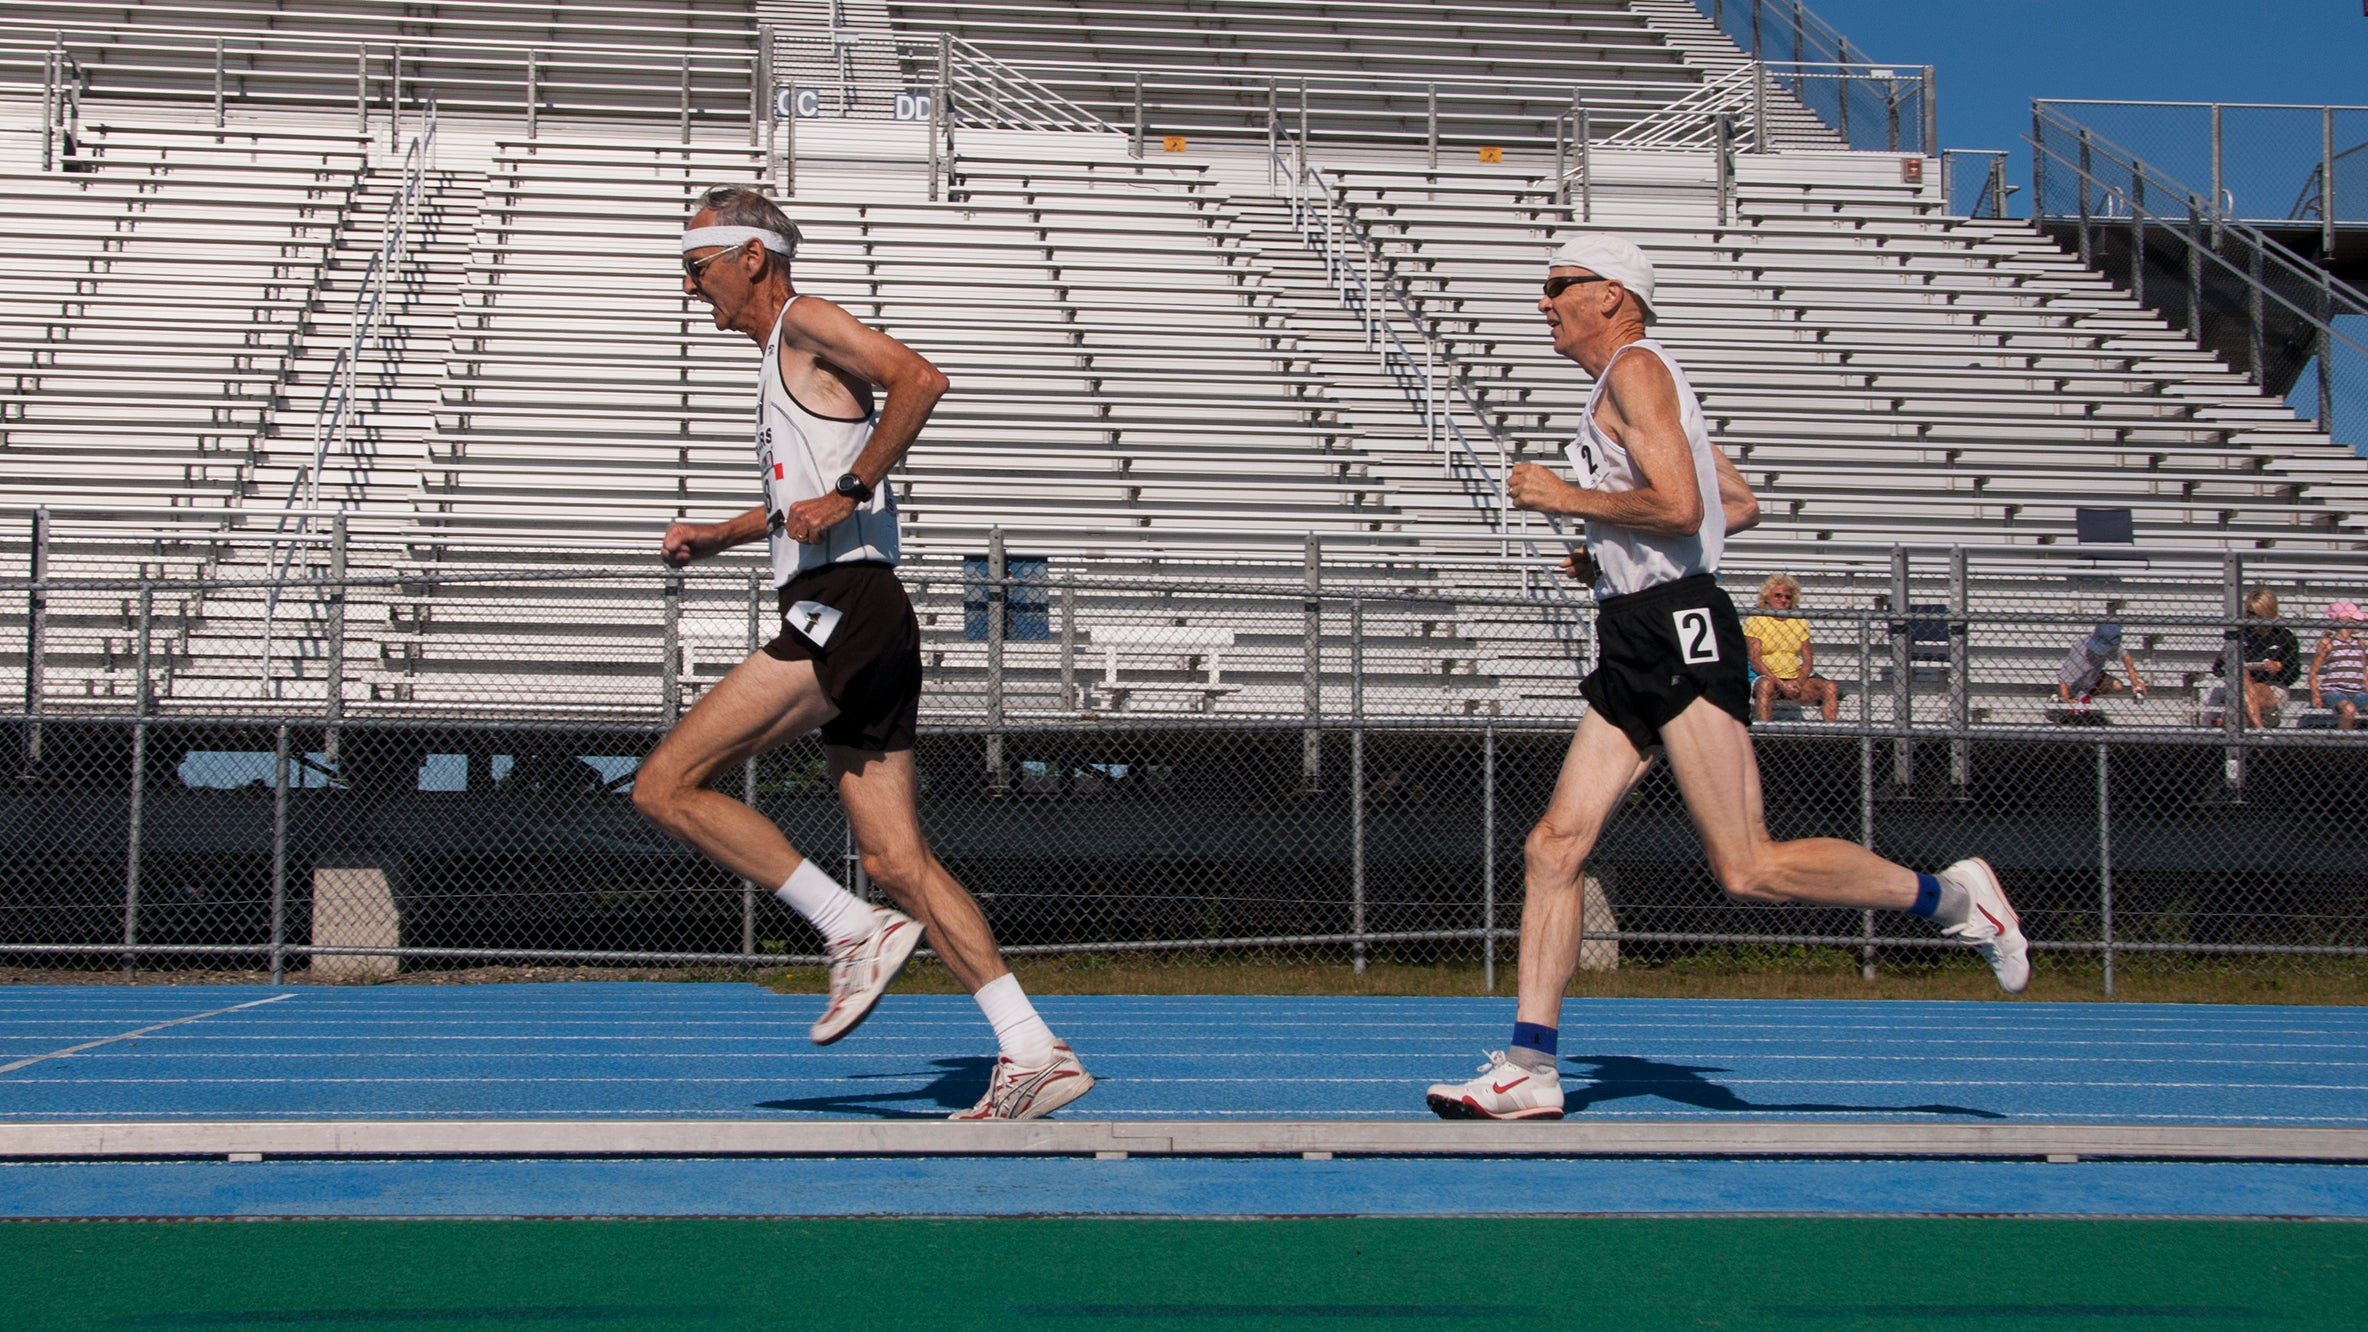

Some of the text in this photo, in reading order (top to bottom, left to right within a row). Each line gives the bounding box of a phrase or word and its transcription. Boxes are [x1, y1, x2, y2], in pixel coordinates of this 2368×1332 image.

[897, 96, 931, 120] DD
[1581, 445, 1599, 475] 2
[804, 612, 821, 634] 1
[1682, 613, 1713, 658] 2
